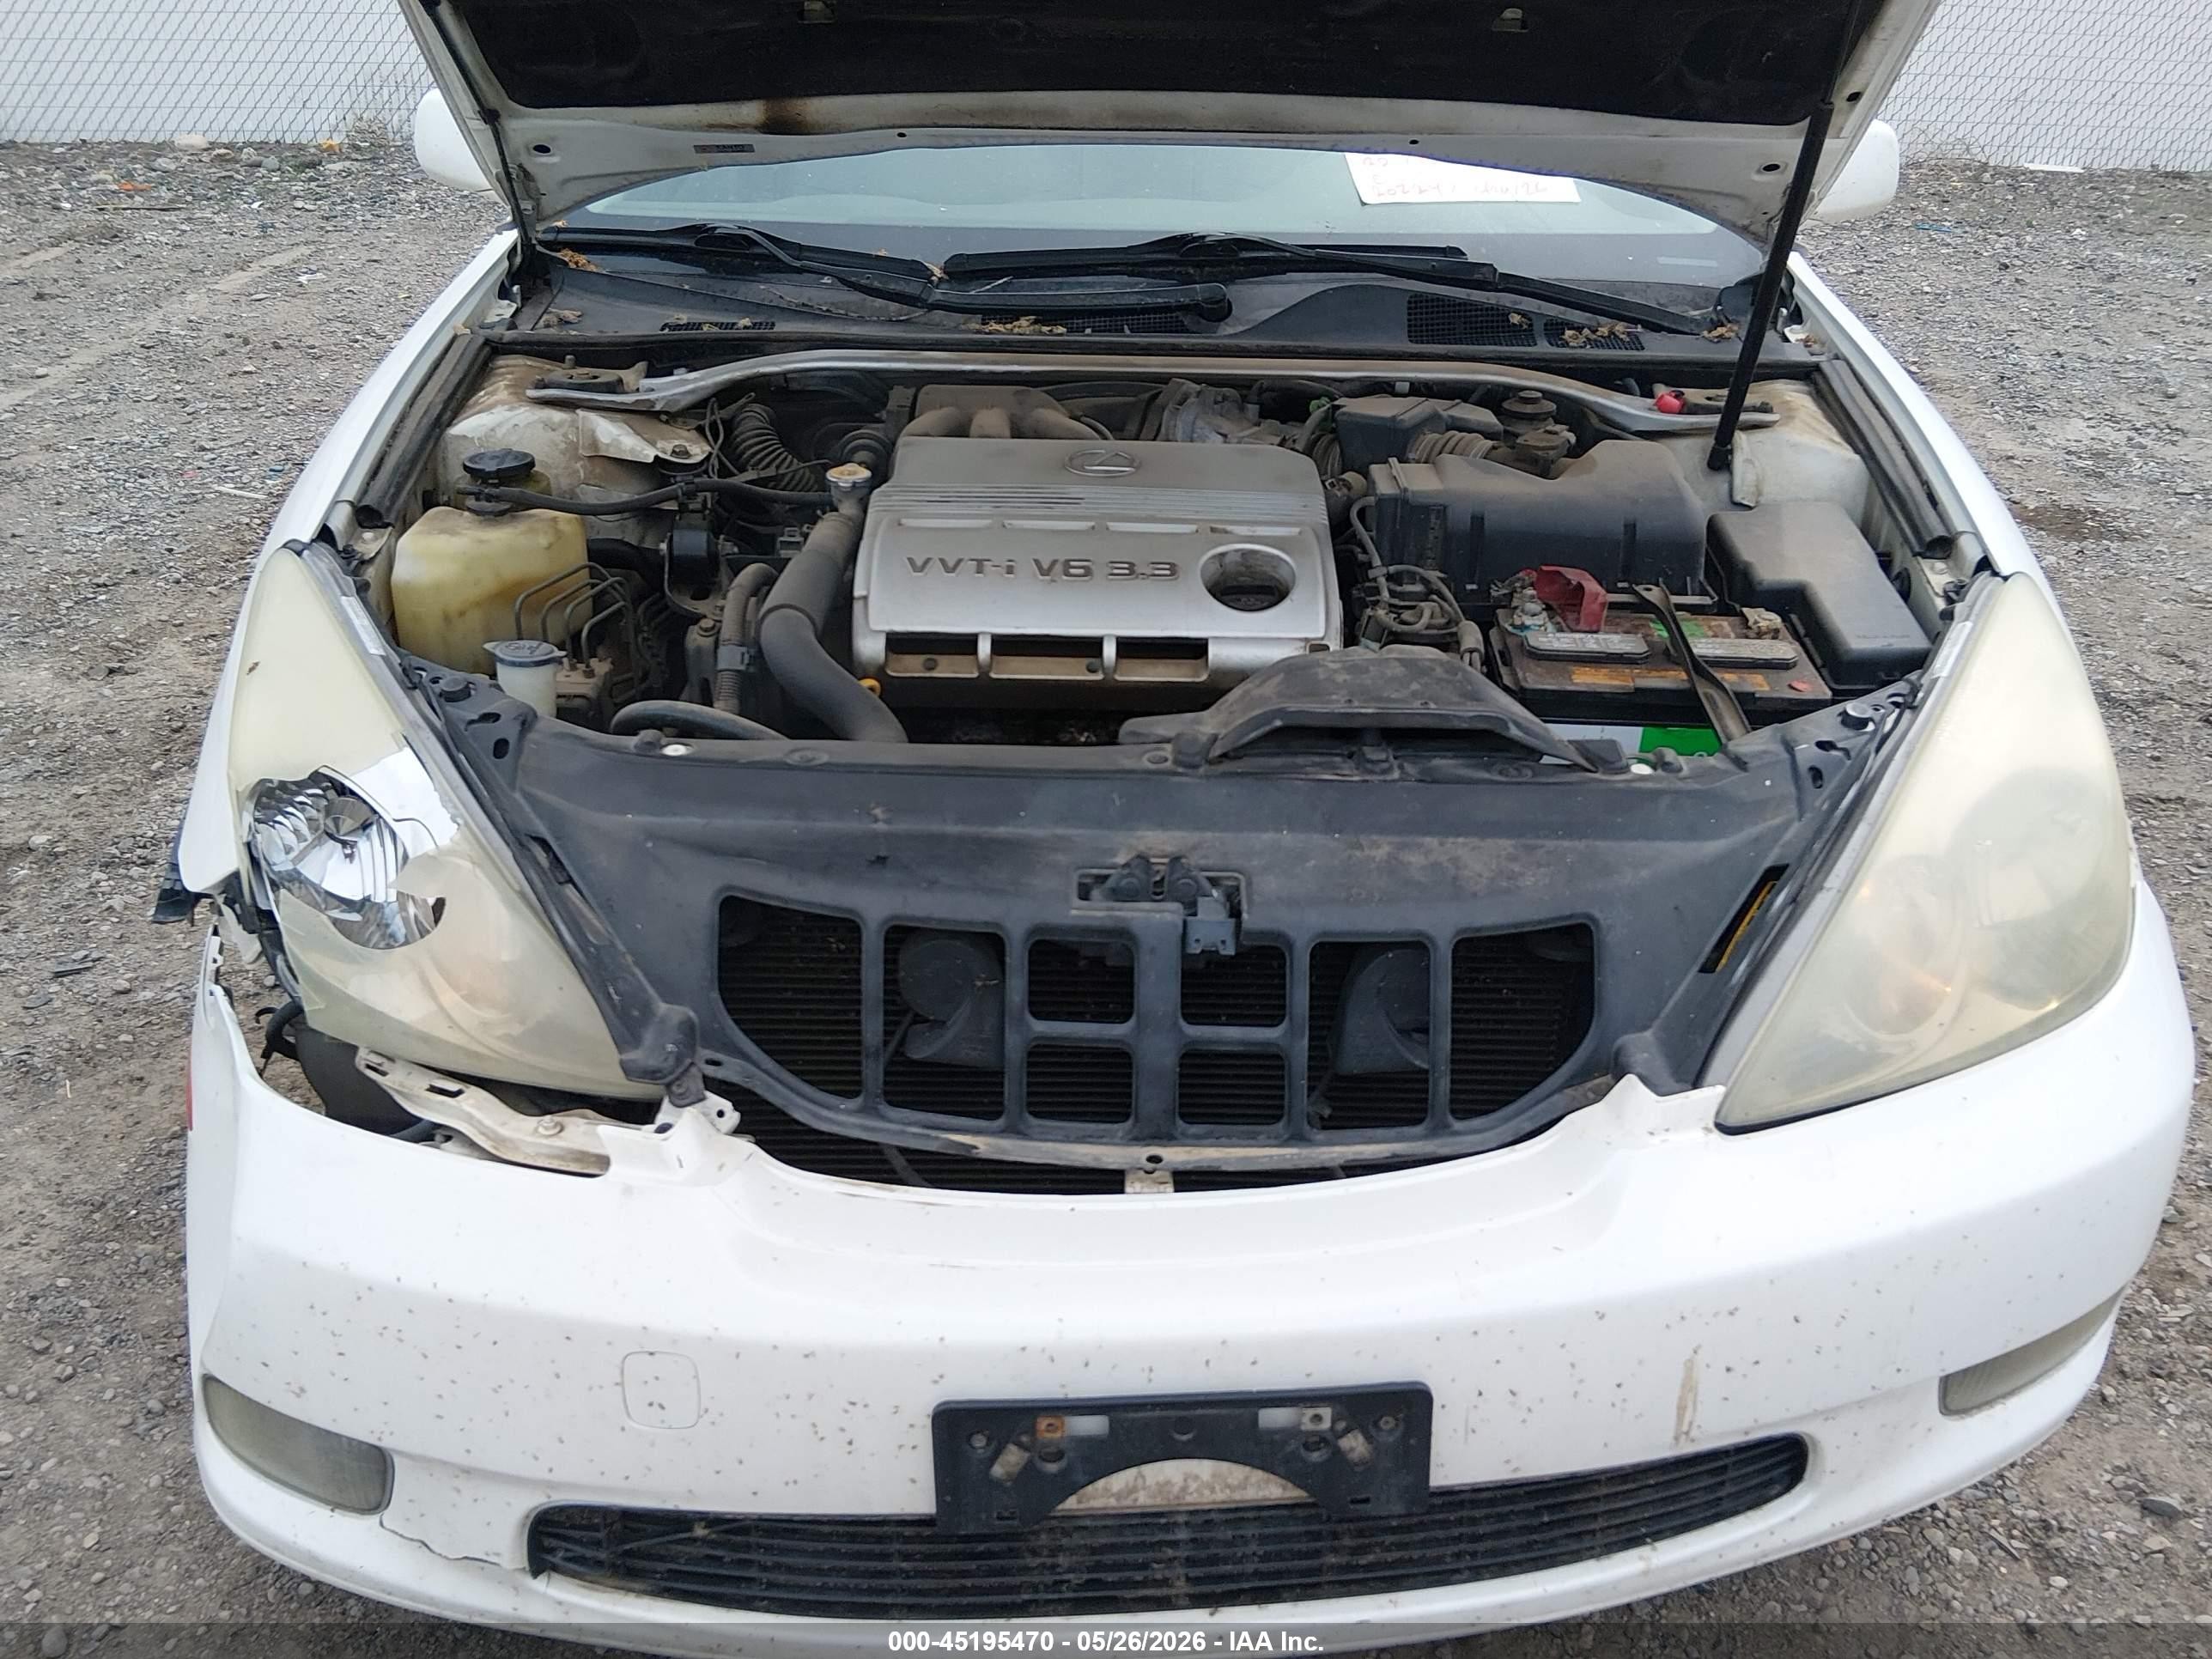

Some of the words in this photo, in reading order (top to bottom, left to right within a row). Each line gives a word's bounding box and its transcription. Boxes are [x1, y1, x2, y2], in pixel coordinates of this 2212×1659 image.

[906, 556, 1015, 577] VVT-i
[1032, 557, 1093, 580] V6
[1108, 560, 1179, 580] 3.3
